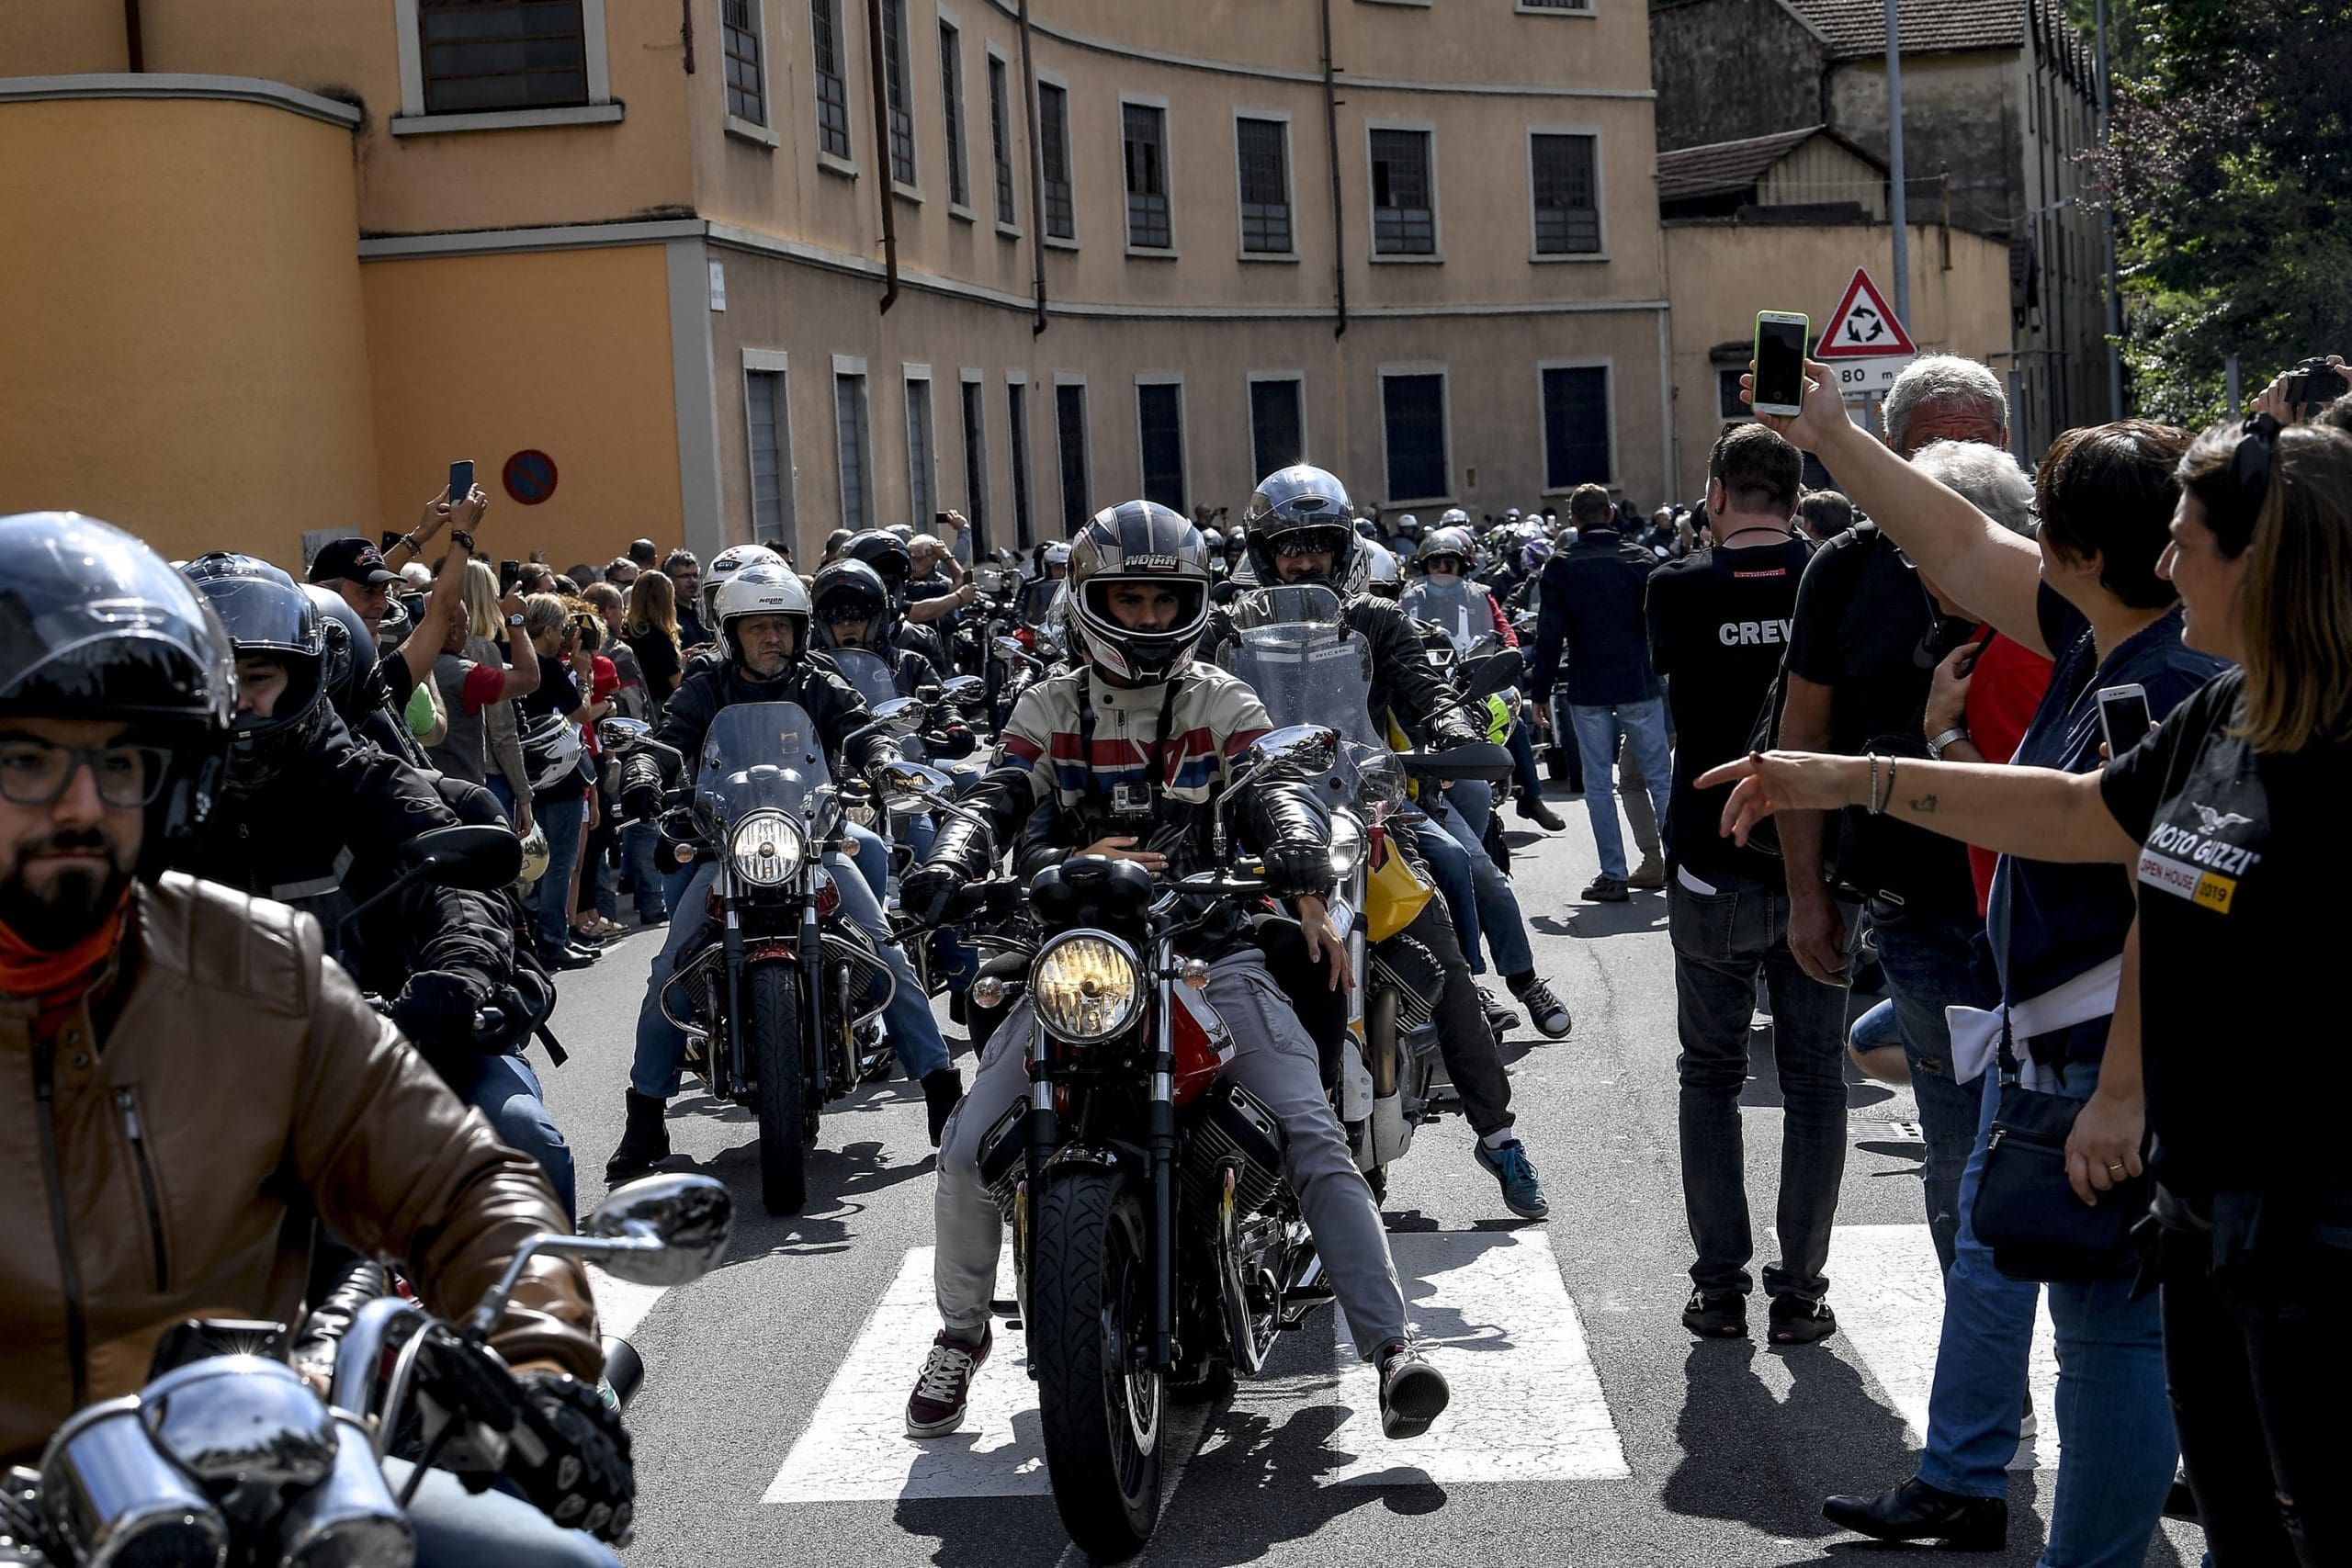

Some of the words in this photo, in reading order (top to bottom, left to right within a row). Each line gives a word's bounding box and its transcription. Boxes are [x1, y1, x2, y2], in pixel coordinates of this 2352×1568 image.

[1841, 368, 1865, 382] 80
[1882, 371, 1893, 379] m
[1125, 554, 1177, 569] NOLAN
[2148, 822, 2199, 854] MOTO
[2193, 840, 2254, 875] GUZZI
[2141, 858, 2163, 878] OPEN
[2164, 866, 2194, 890] HOUSE
[2199, 881, 2227, 902] 2019
